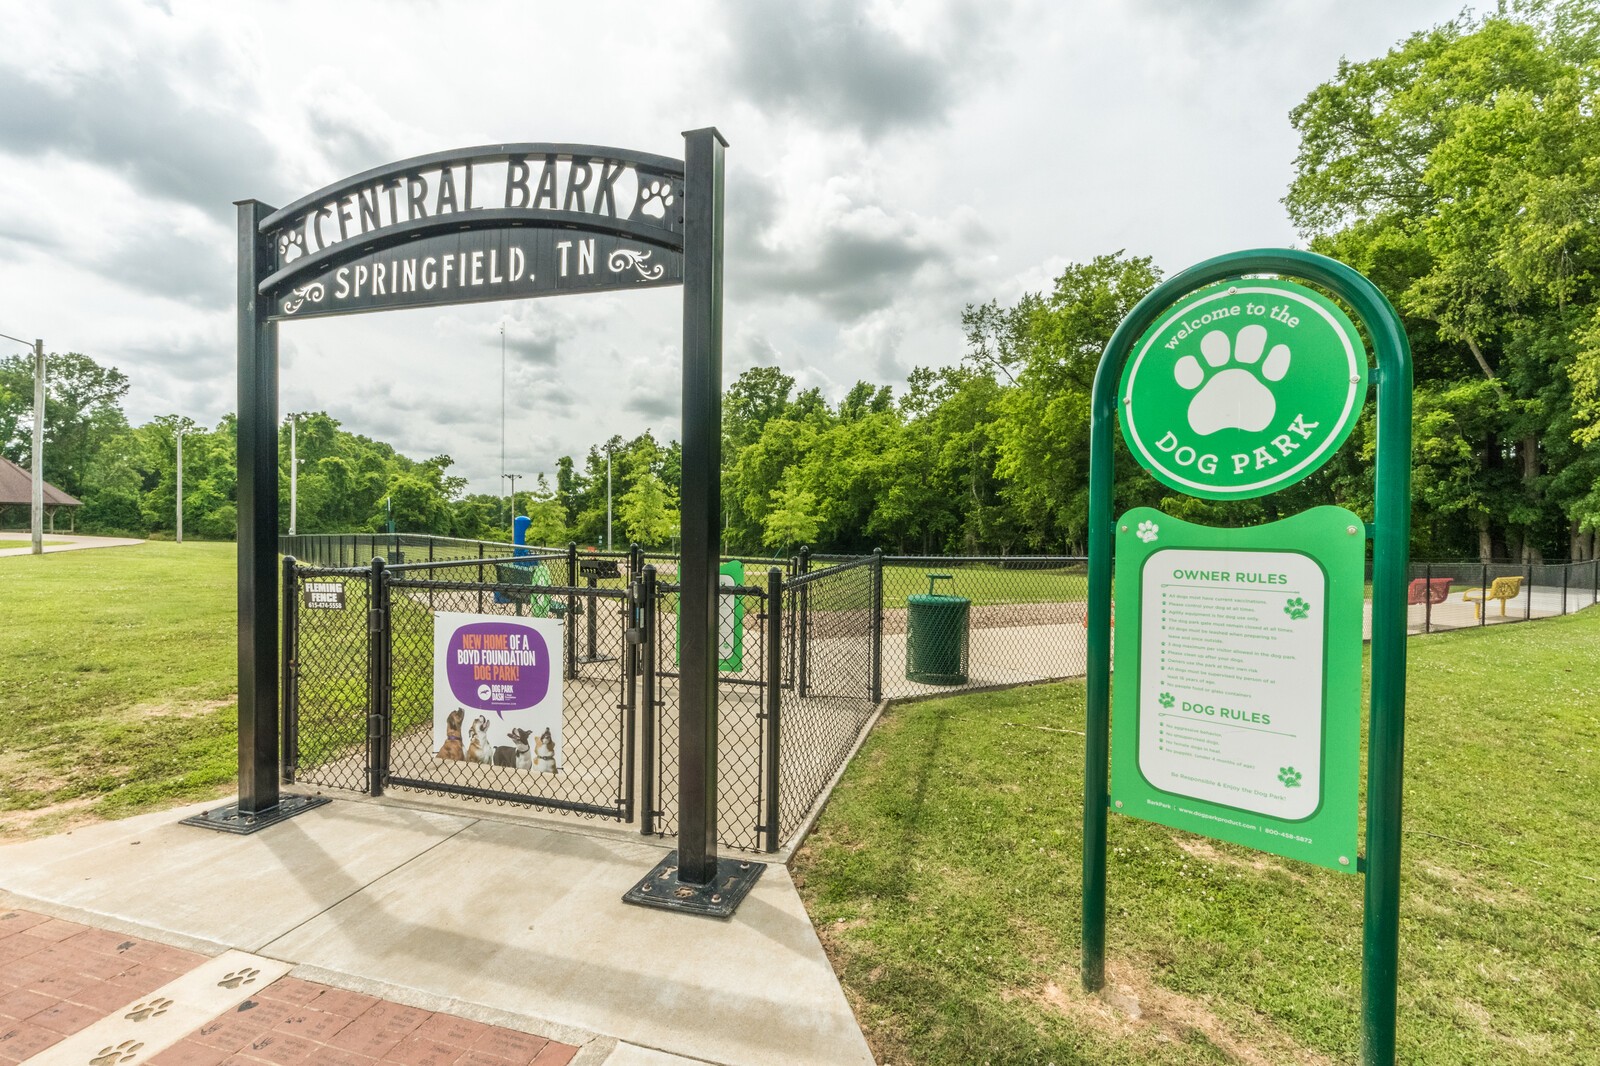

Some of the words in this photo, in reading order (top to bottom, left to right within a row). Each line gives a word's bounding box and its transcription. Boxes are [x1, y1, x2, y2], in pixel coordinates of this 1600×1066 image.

[314, 158, 484, 248] CENTRAL
[504, 154, 626, 218] BARK
[557, 238, 595, 277] TN
[1164, 304, 1241, 351] welcome
[1246, 302, 1266, 316] to
[1269, 304, 1300, 328] the
[1154, 430, 1219, 475] DOG
[1231, 413, 1320, 475] PARK
[1173, 569, 1231, 582] OWNER
[1235, 572, 1288, 585] RULES
[305, 583, 343, 593] FLEMING
[311, 593, 338, 602] FENCE
[462, 634, 481, 649] NEW
[483, 634, 508, 650] HOME
[509, 634, 520, 650] OF
[522, 634, 529, 651] A
[1244, 633, 1270, 641] preparing
[457, 649, 480, 665] BOYD
[482, 650, 536, 666] FOUNDATION
[474, 665, 491, 681] DOG
[493, 665, 520, 681] PARK!
[491, 684, 500, 693] DOG
[501, 684, 513, 693] PARK
[1181, 701, 1215, 716] DOG
[1220, 707, 1271, 725] RULES
[1174, 725, 1199, 733] aggressive
[1216, 758, 1235, 766] months
[1180, 773, 1216, 786] Responsible
[1223, 783, 1240, 792] Enjoy
[1253, 789, 1268, 798] Dog
